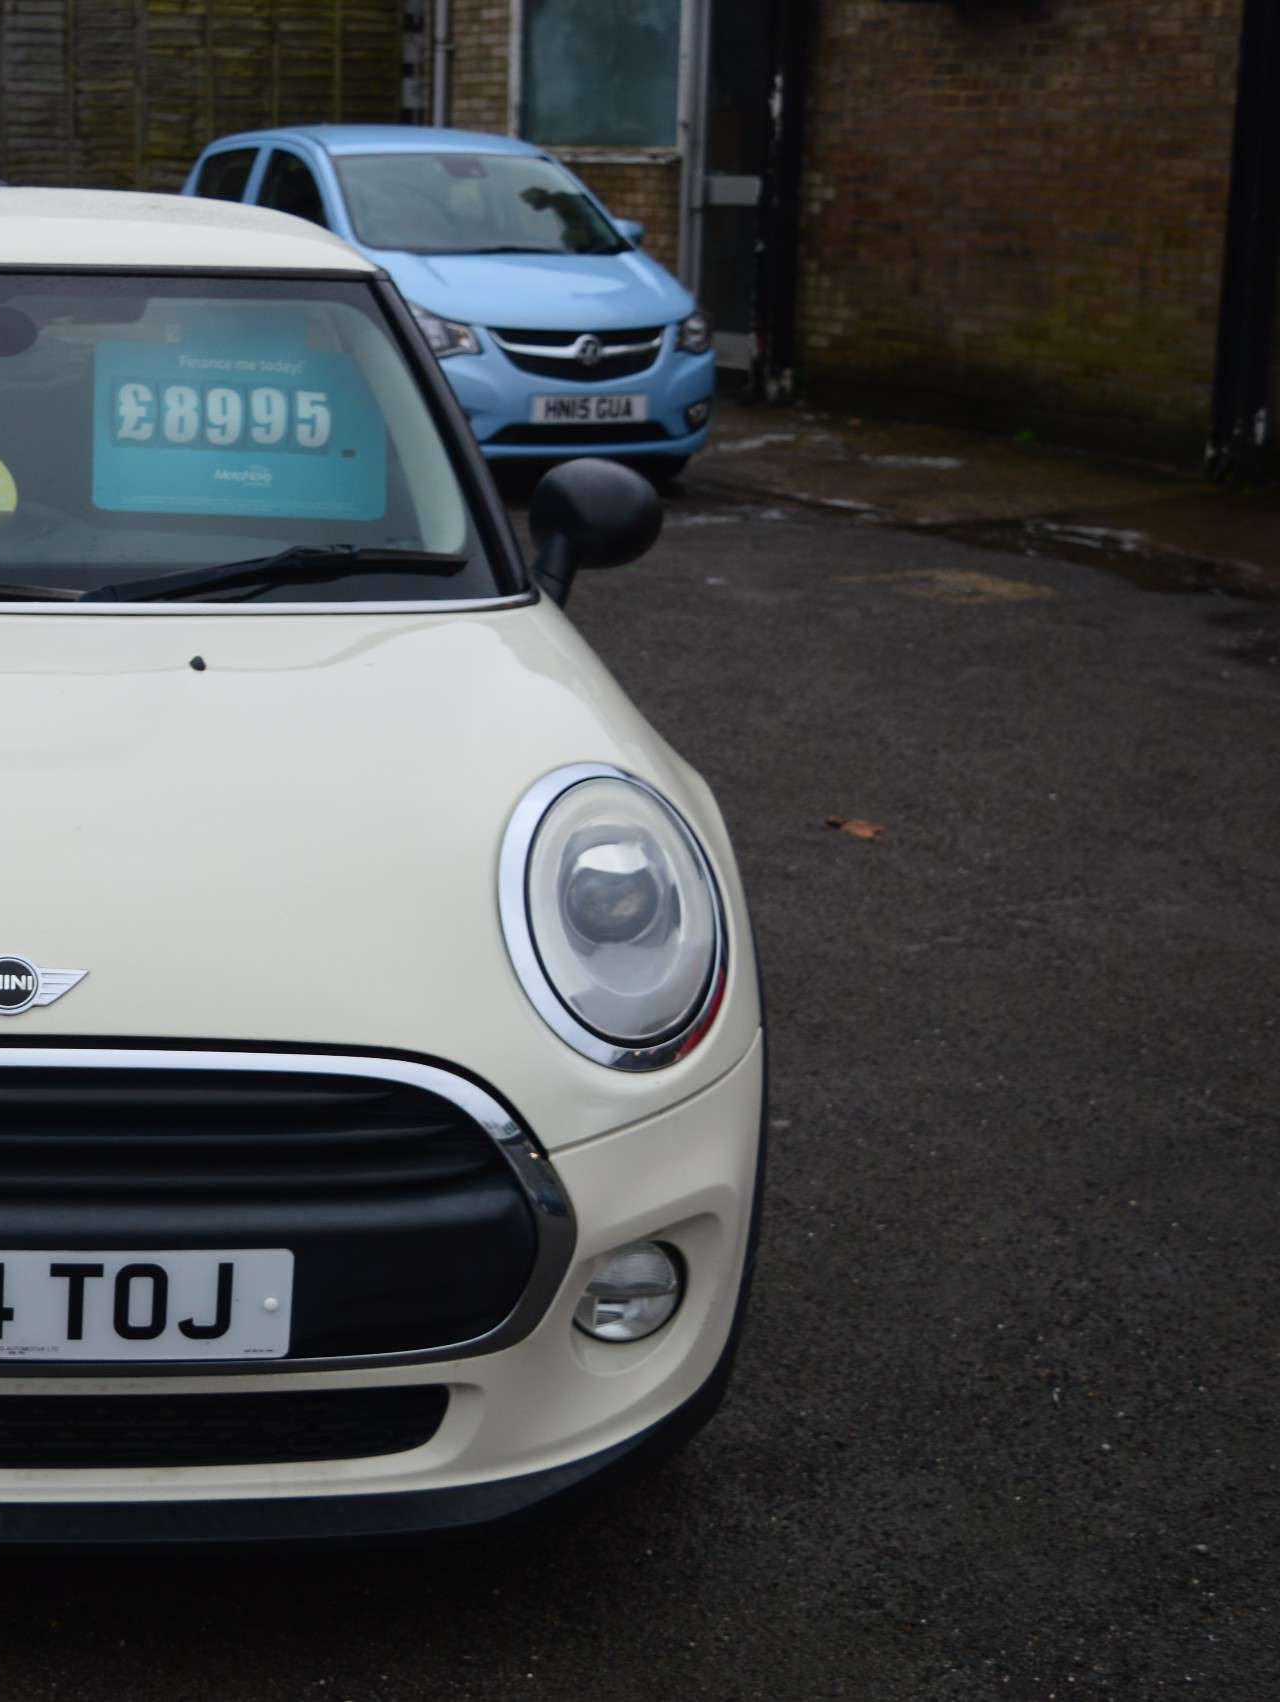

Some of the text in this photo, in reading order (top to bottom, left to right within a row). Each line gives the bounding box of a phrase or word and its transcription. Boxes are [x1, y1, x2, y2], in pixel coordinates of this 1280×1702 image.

[117, 383, 331, 448] £8995
[544, 398, 633, 419] HN15 GUA
[50, 1262, 234, 1340] TOJ
